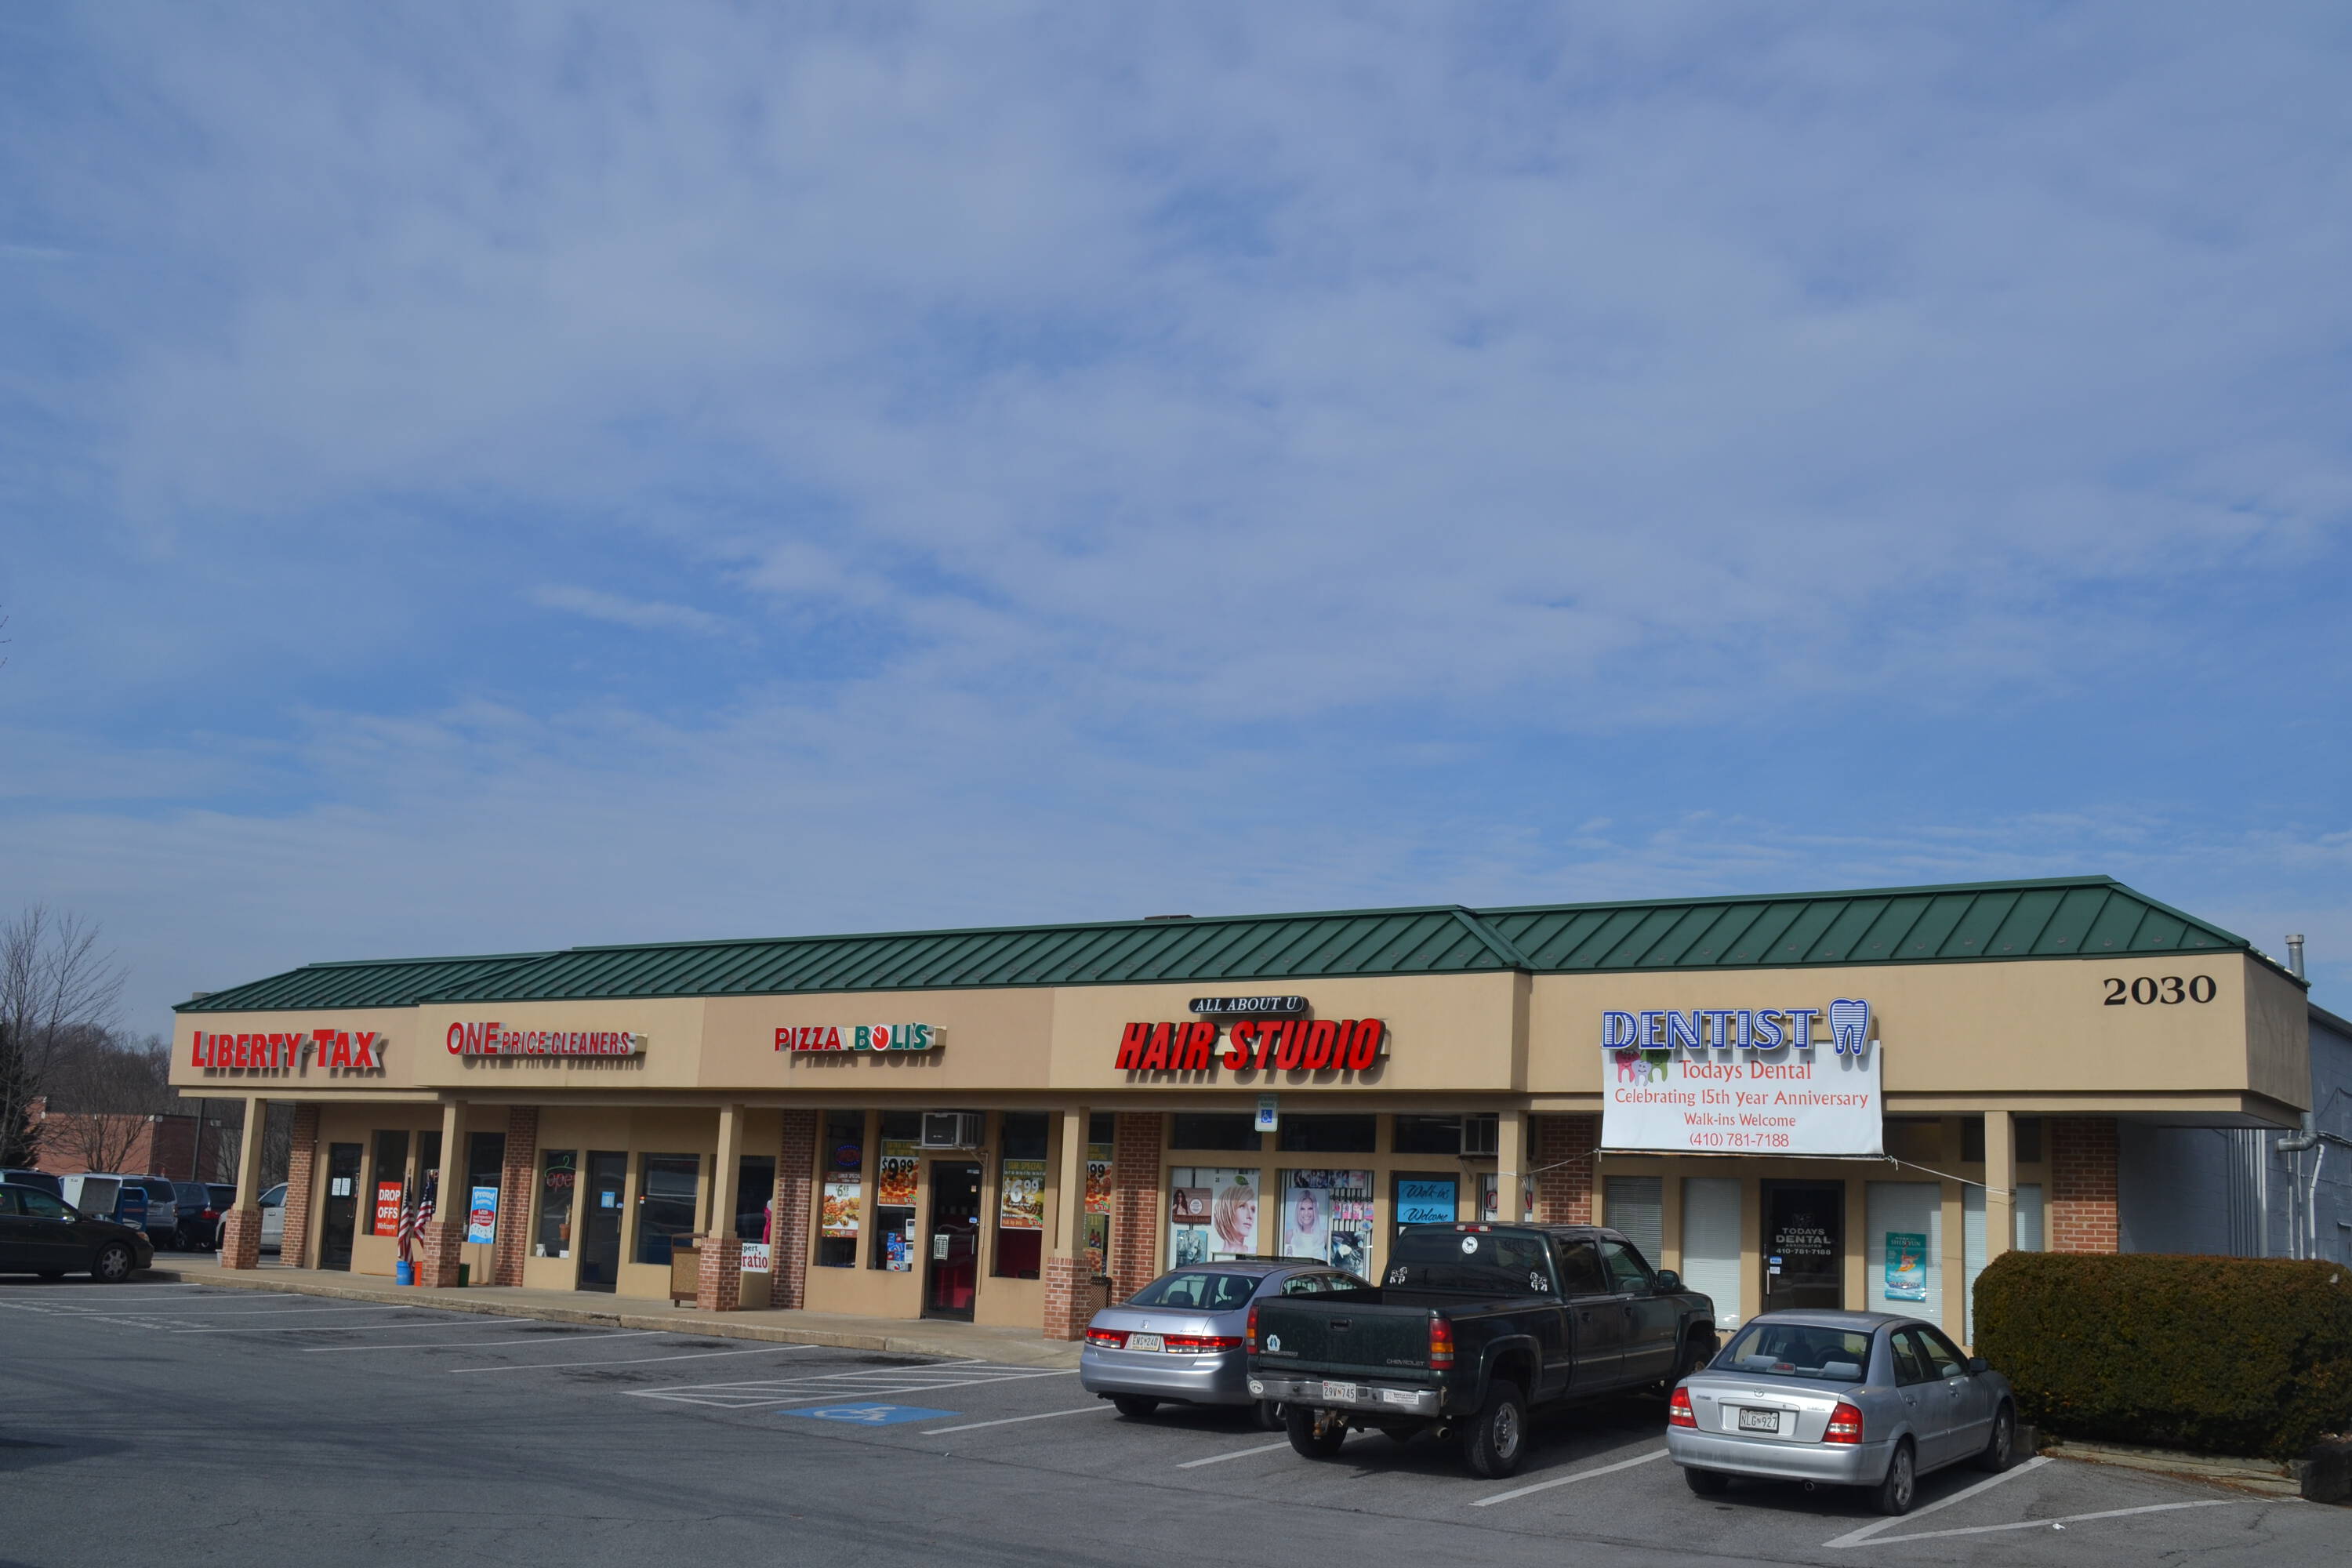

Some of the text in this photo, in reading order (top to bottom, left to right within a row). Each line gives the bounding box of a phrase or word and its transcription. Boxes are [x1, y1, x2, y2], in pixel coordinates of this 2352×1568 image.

[2103, 975, 2217, 1006] 2030
[1195, 996, 1298, 1012] ALL ABOUT U
[446, 1022, 633, 1055] ONE PRICE CLEANERS
[774, 1025, 844, 1051] PIZZA
[1601, 1008, 1820, 1050] DENTIST
[191, 1029, 380, 1068] LIBERTY TAX
[1114, 1018, 1385, 1071] HAIR STUDIO
[1679, 1059, 1812, 1083] Todays Dental
[1615, 1087, 1696, 1107] Celebrating
[1701, 1089, 1730, 1105] 15th
[1774, 1090, 1869, 1109] Anniversary
[1684, 1112, 1796, 1127] Walk-ins Welcome
[1689, 1133, 1790, 1148] (410) 781-7188
[379, 1189, 401, 1201] DROP
[377, 1207, 398, 1219] OFFS
[1403, 1207, 1449, 1221] Welcome
[1775, 1235, 1831, 1244] DENTAL
[1781, 1227, 1825, 1236] TODAYS
